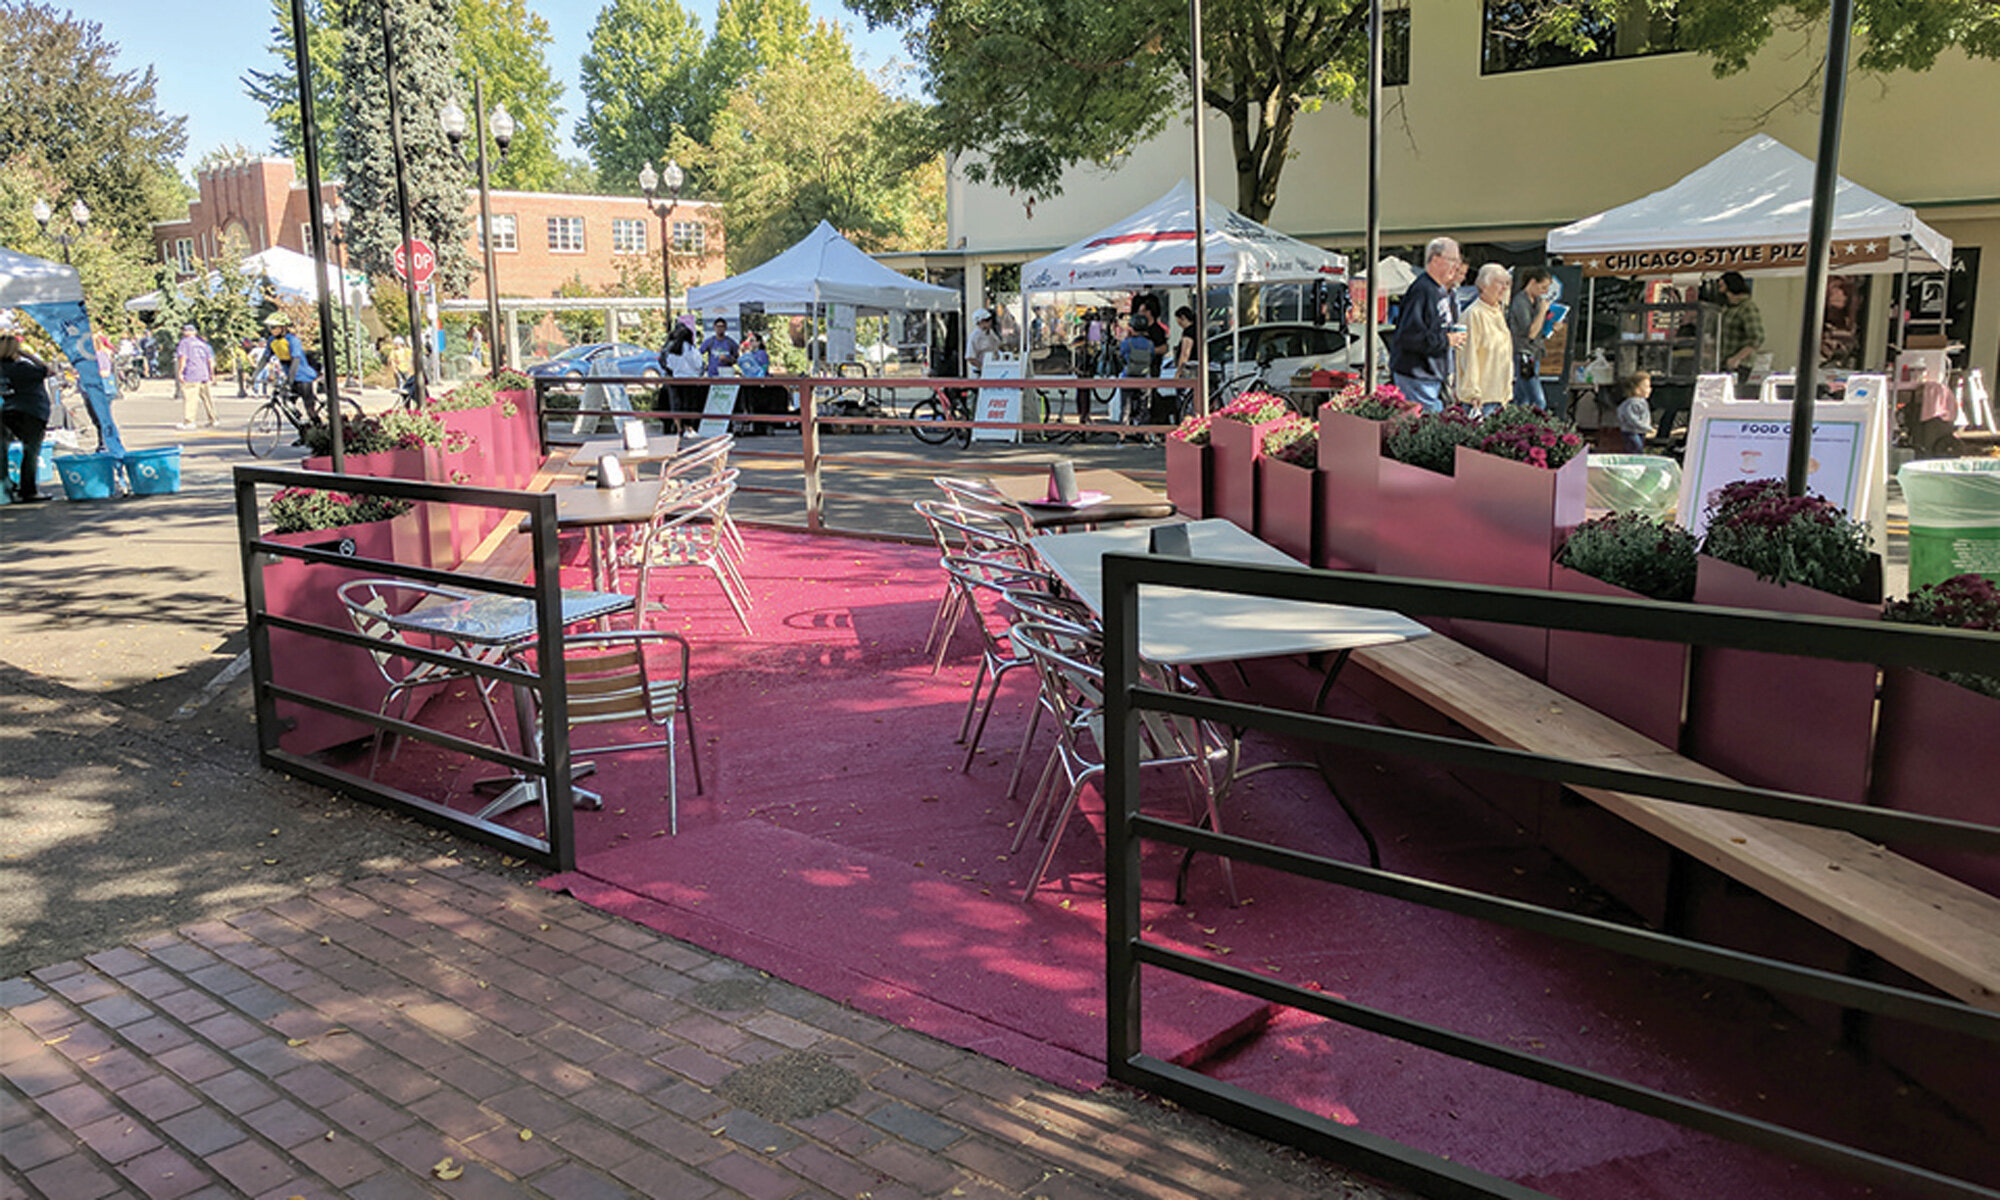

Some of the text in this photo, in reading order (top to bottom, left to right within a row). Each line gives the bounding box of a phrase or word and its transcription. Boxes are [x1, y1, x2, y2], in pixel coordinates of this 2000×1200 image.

[398, 252, 432, 269] SOP
[1770, 245, 1838, 263] PIZ
[1740, 424, 1780, 434] FOOD
